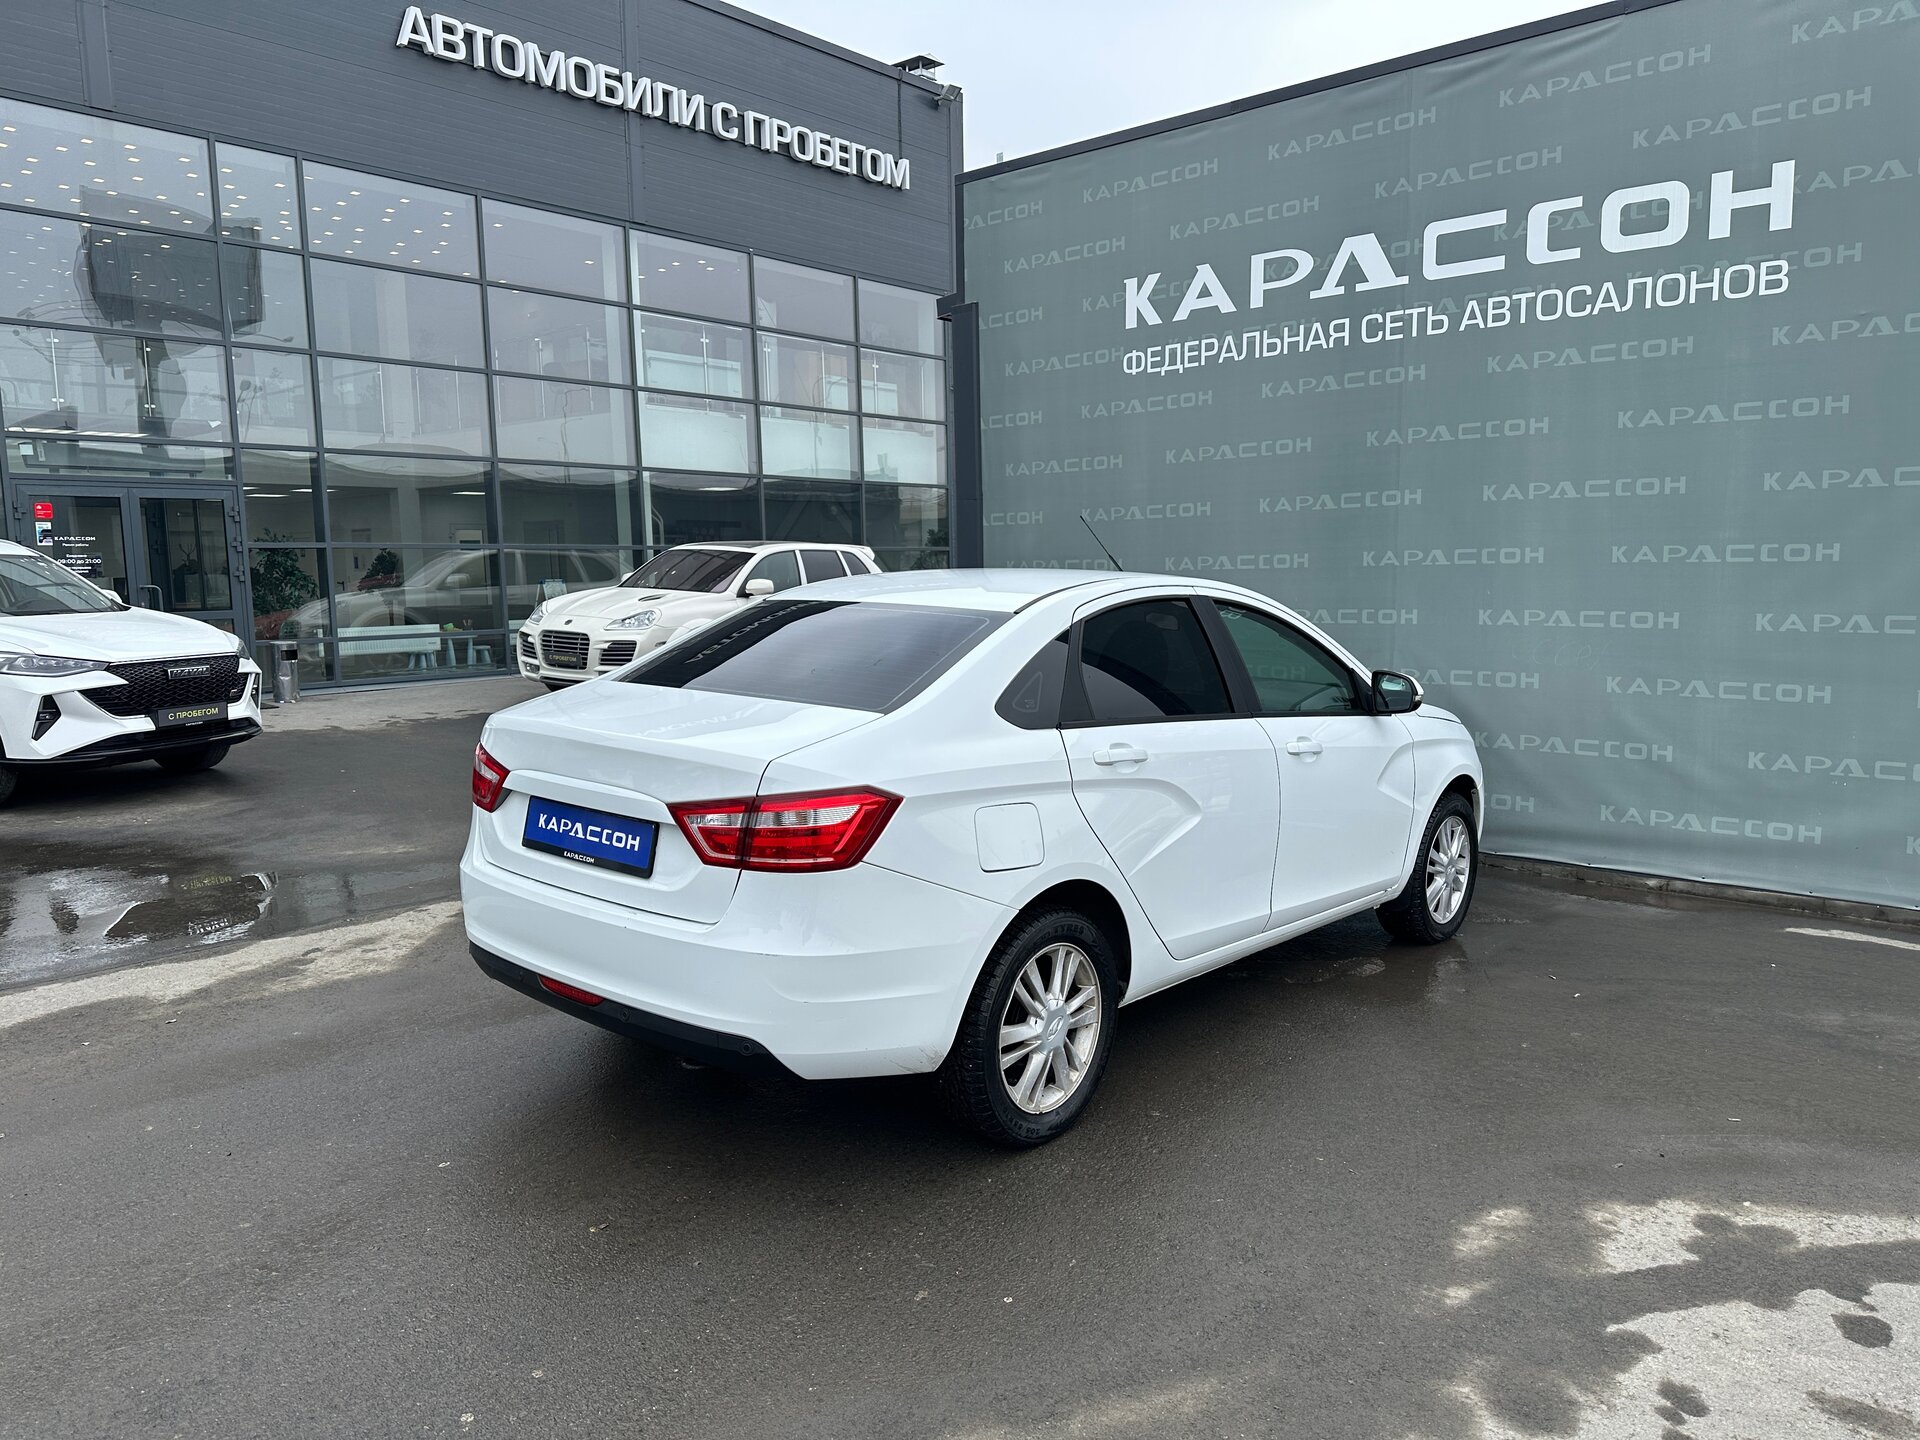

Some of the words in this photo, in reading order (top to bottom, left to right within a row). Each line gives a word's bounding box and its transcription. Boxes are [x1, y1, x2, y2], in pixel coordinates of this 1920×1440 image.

[396, 5, 705, 131] АВТОМОБИЛИ
[712, 101, 738, 141] С
[744, 110, 910, 190] ПРОБЕГОМ
[1123, 159, 1796, 330] КАРАССОН
[1123, 318, 1350, 376] ФЕДЕРАЛЬНАЯ
[1361, 306, 1449, 344] СЕТЬ
[1459, 259, 1790, 331] АВТОСАЛОНОВ
[176, 707, 219, 719] ПРОБЕГОМ
[537, 813, 641, 852] КАРАССОН
